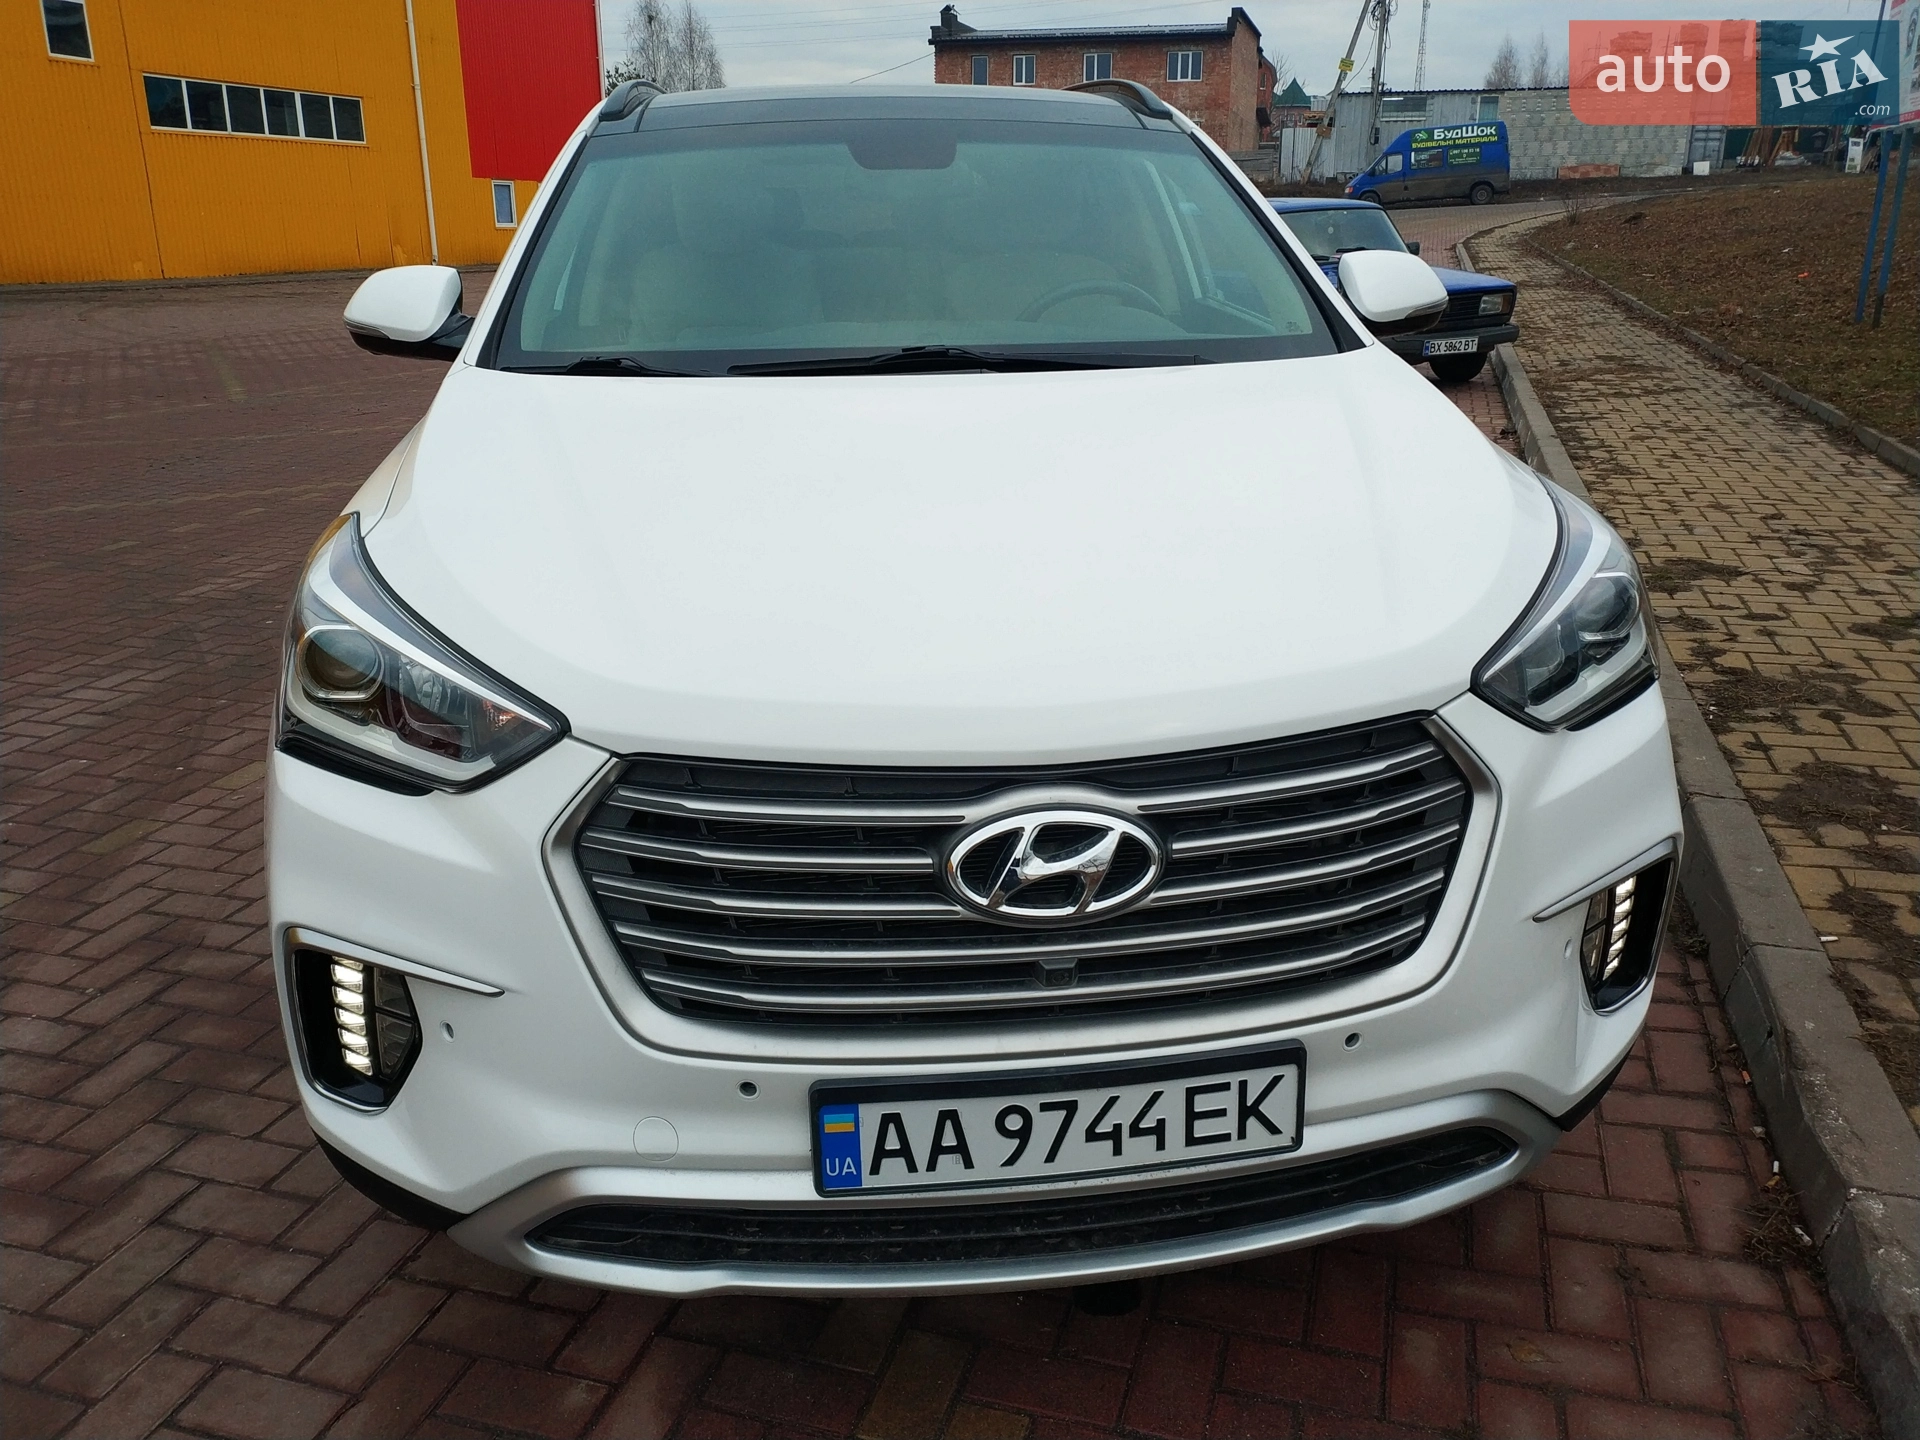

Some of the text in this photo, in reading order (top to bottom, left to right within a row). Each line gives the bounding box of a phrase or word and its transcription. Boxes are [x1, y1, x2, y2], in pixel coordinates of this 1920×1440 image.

[1444, 341, 1462, 352] 5862
[994, 1090, 1166, 1168] 9744
[825, 1157, 857, 1177] UA
